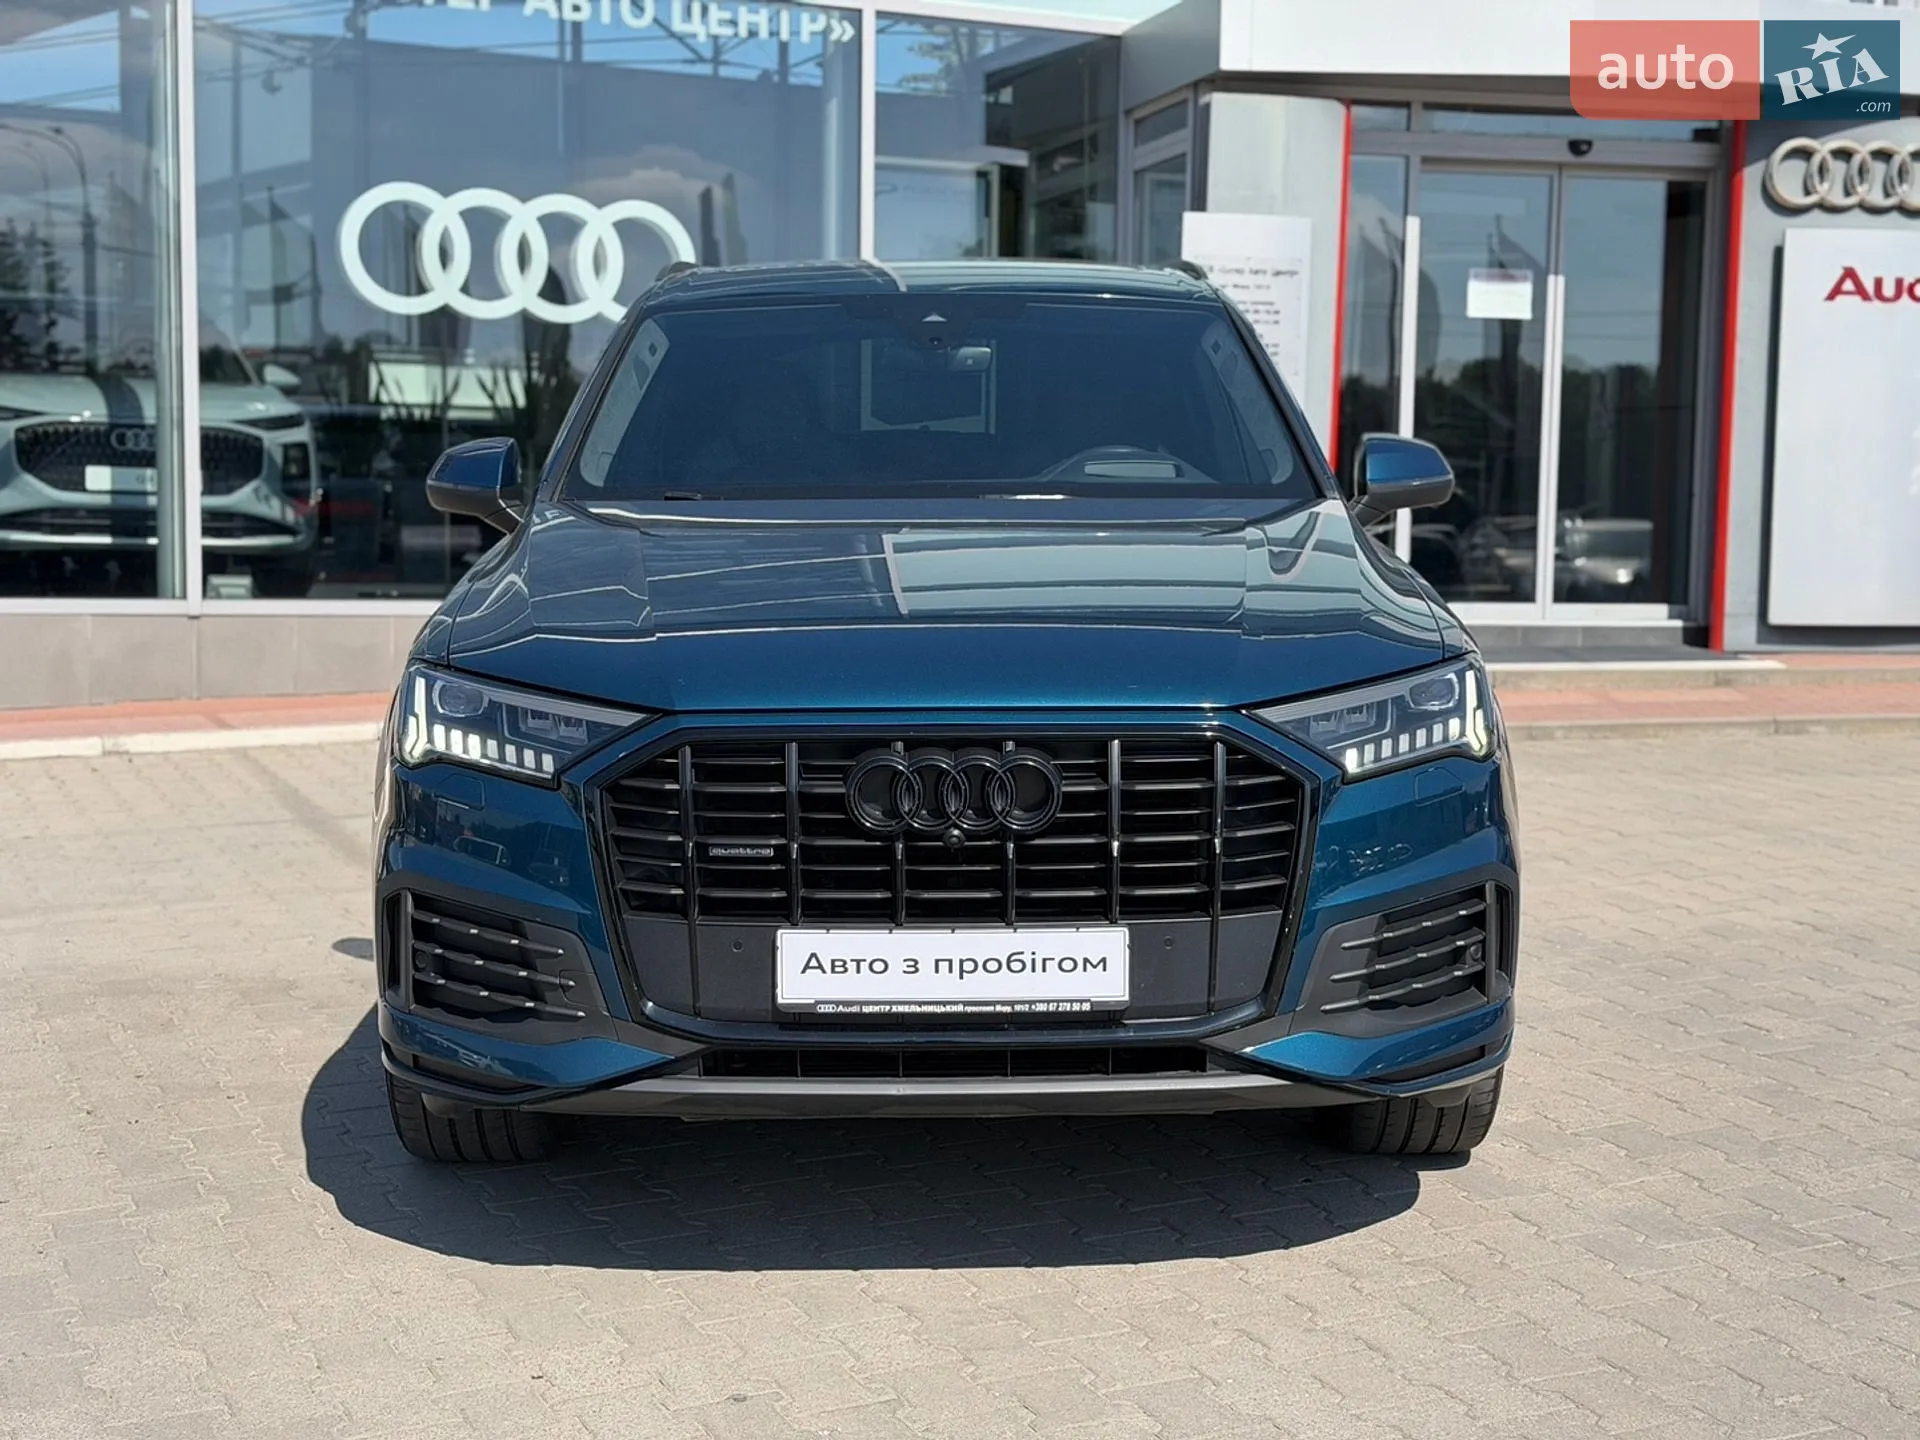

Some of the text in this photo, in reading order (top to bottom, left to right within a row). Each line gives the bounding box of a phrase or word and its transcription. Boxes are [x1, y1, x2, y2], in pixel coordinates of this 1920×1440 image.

[800, 951, 1108, 980] Авто з пробігом
[837, 1004, 860, 1013] Audi
